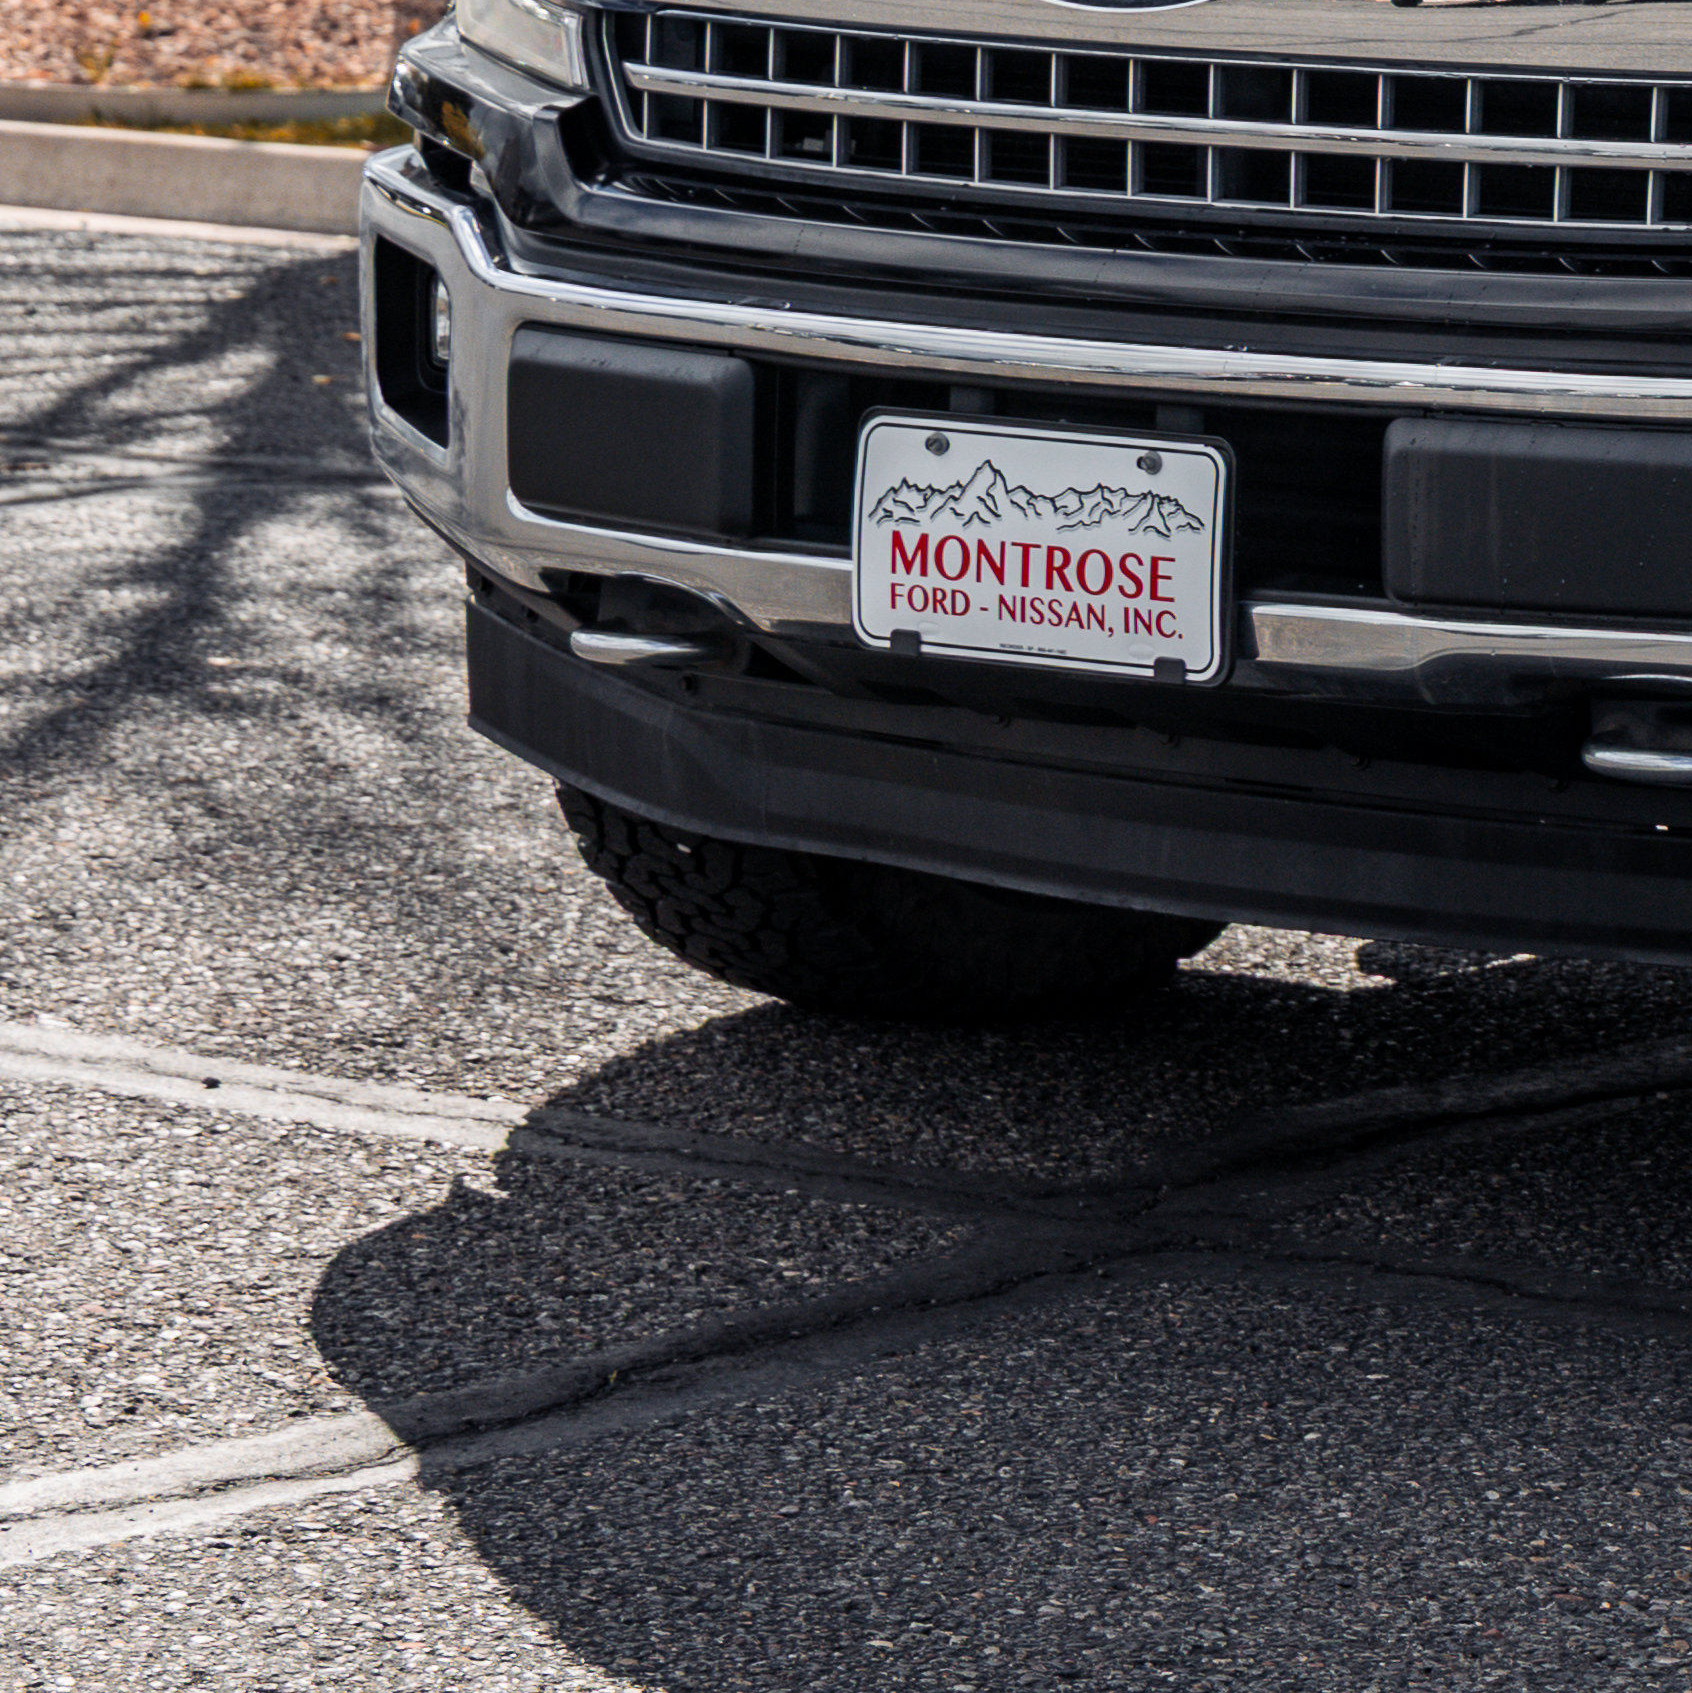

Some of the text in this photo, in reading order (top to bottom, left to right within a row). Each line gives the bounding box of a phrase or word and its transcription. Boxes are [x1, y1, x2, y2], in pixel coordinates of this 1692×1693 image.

[890, 529, 1177, 604] MONTROSE
[890, 582, 972, 618] FORD
[998, 594, 1116, 639] NISSAN,
[1122, 606, 1184, 640] INC.
